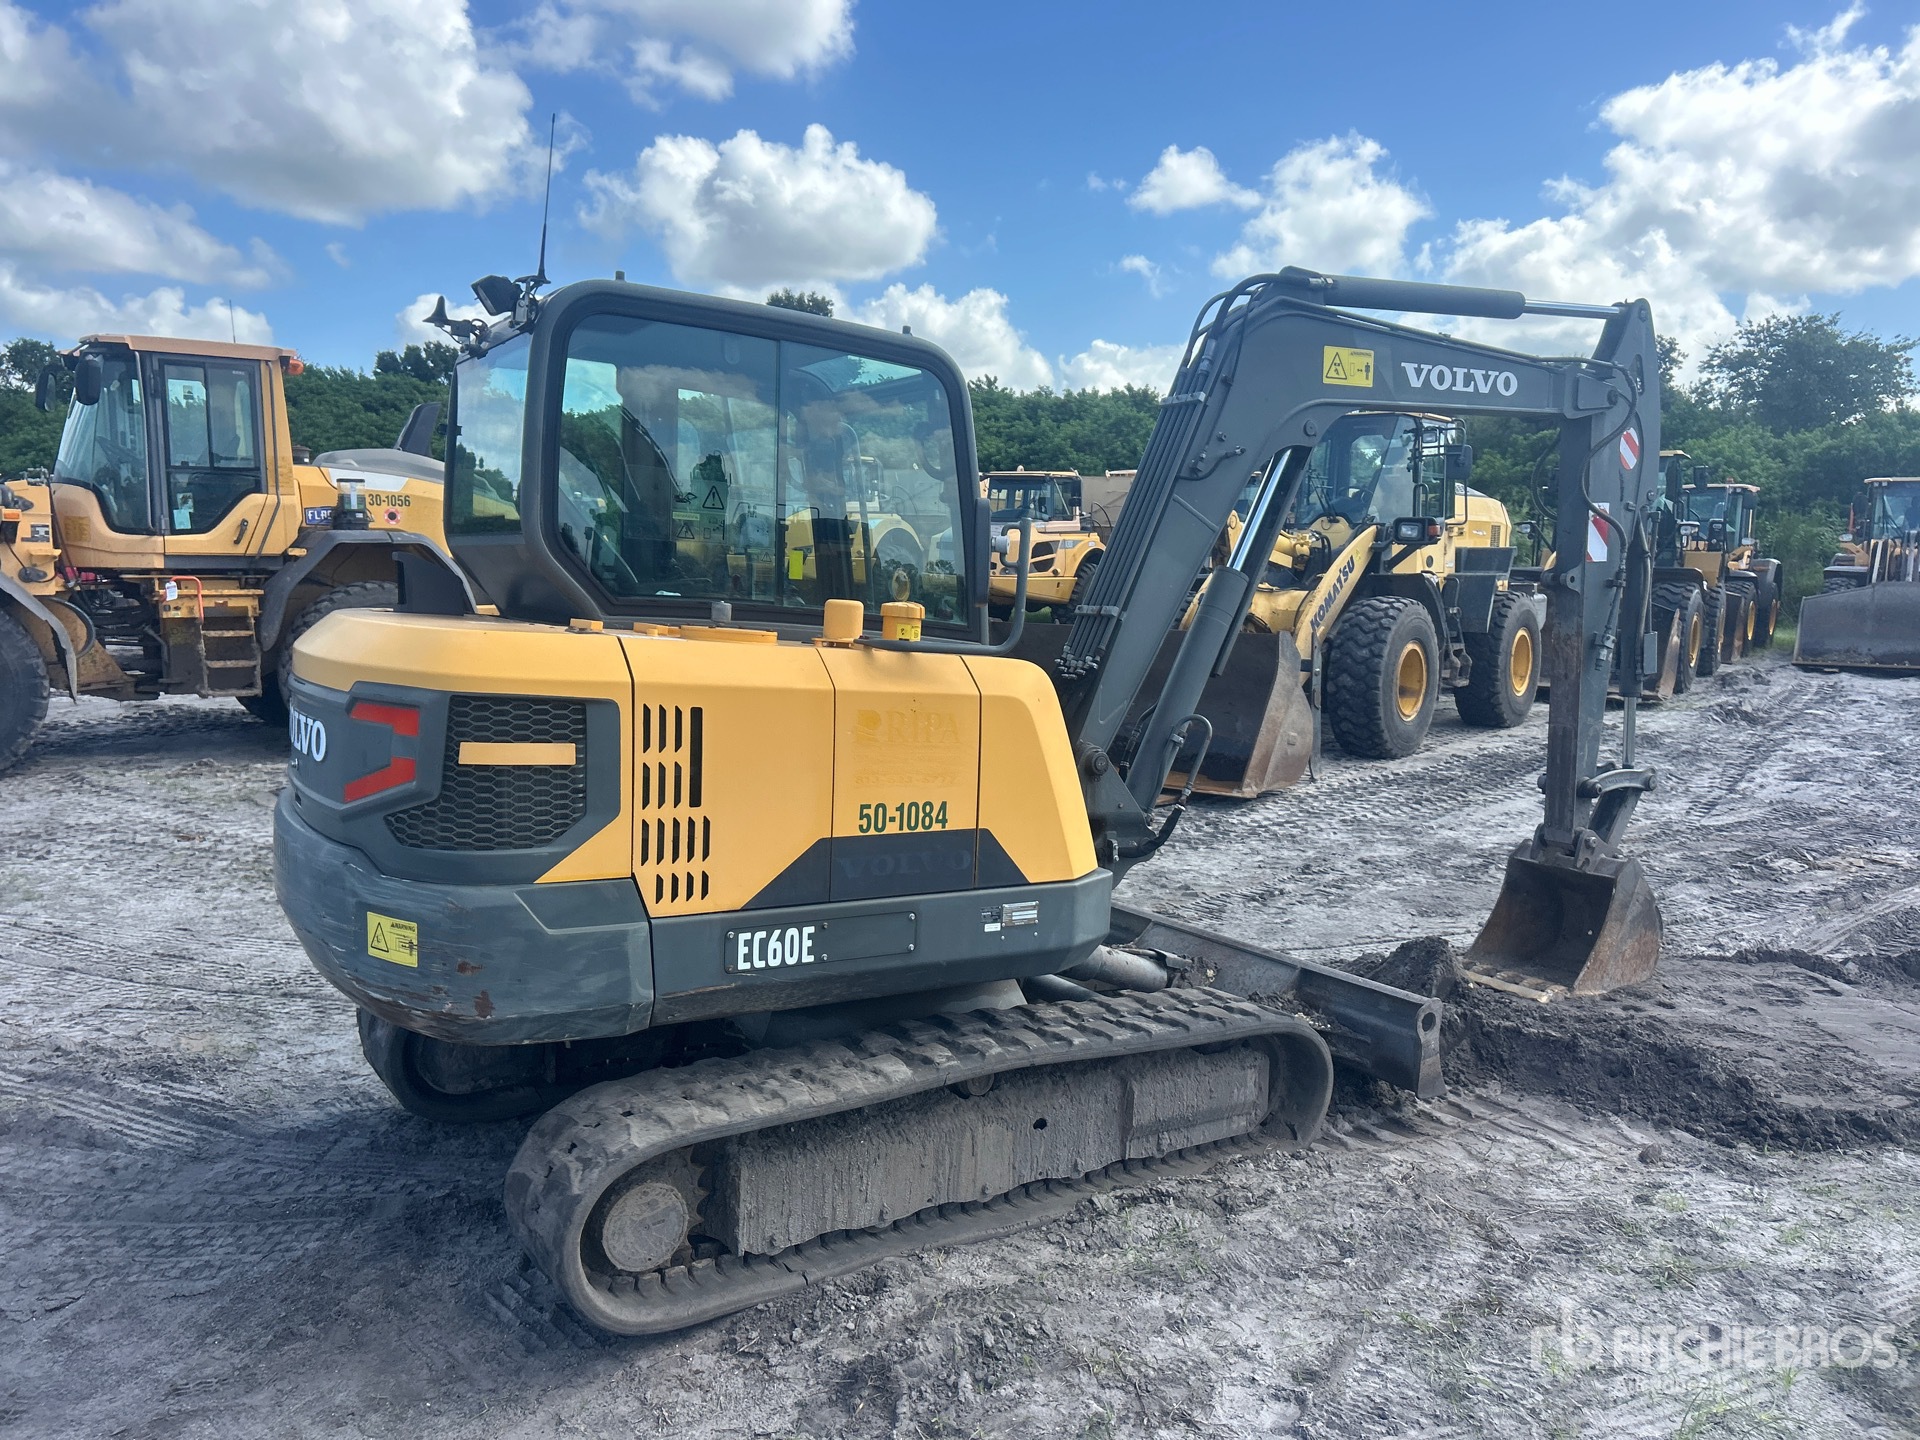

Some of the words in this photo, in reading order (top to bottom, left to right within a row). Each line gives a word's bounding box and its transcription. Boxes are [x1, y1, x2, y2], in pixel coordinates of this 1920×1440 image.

[1401, 362, 1518, 396] VOLVO
[368, 494, 411, 507] 30-1056
[1310, 555, 1355, 632] KOMATSU
[289, 697, 326, 761] OLVO
[886, 710, 961, 744] RIPA
[858, 801, 948, 833] 50-1084
[834, 850, 971, 879] VOLVO
[738, 926, 815, 970] EC60E
